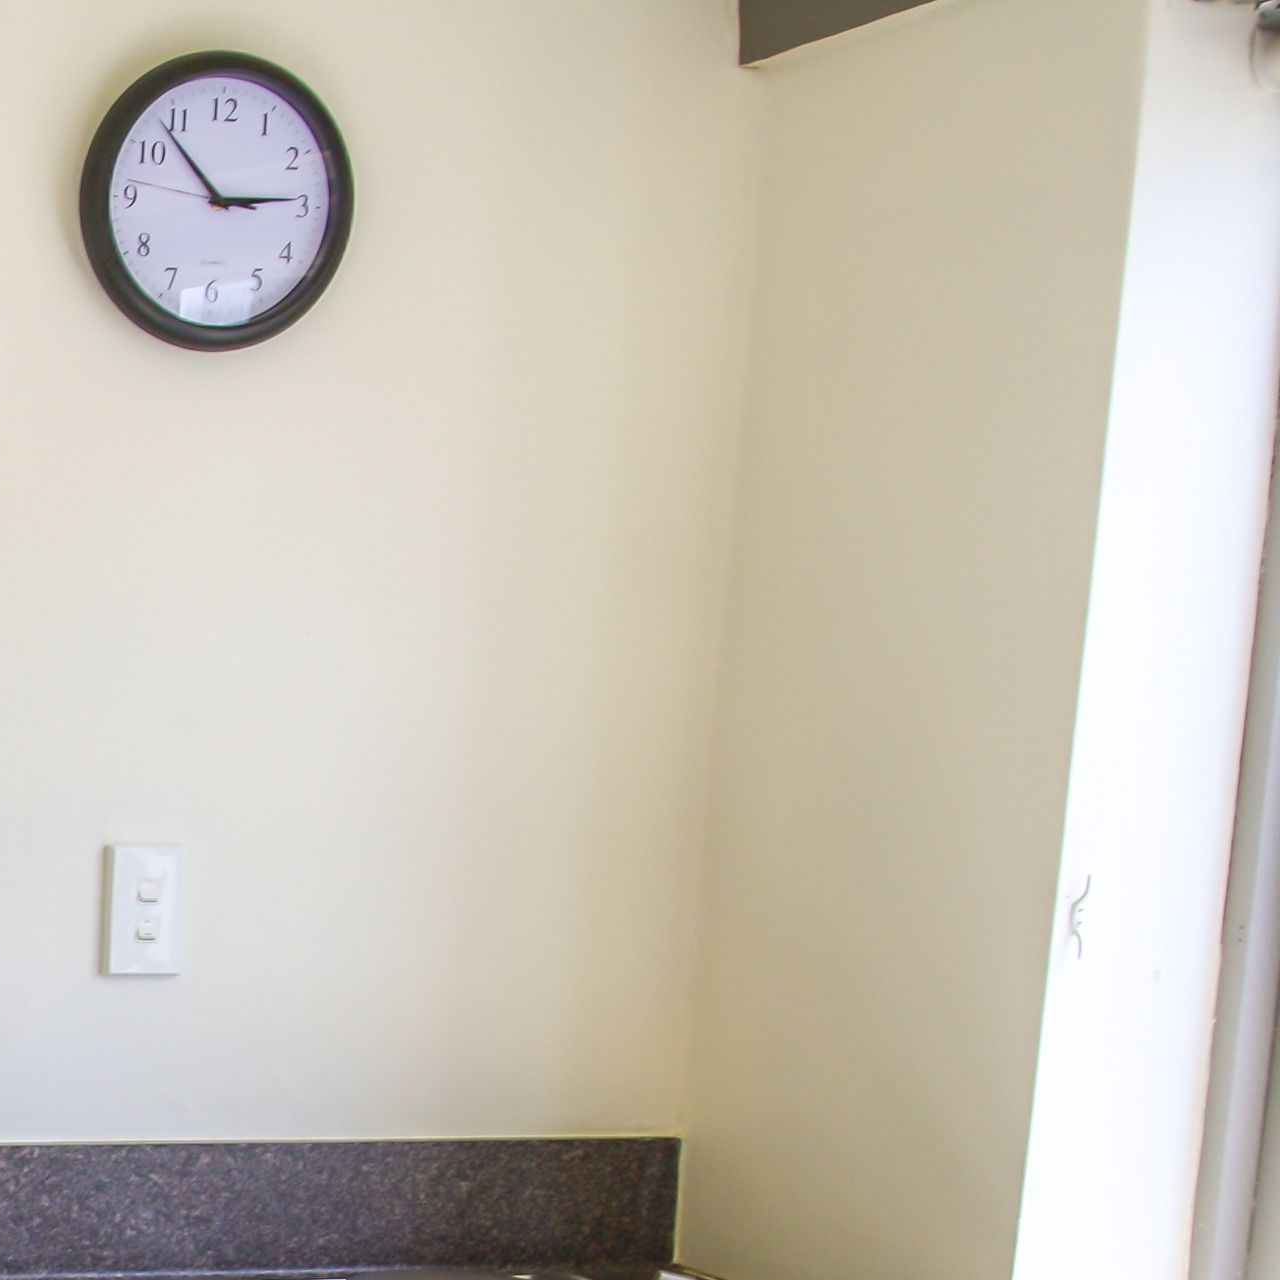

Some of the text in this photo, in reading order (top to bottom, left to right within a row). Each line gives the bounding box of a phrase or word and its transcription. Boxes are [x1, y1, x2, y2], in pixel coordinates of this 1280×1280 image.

[168, 108, 187, 132] 11
[211, 97, 238, 122] 12
[260, 112, 271, 136] 1
[138, 140, 166, 165] 10
[285, 146, 299, 170] 2
[123, 183, 138, 209] 9
[295, 194, 310, 218] 3
[137, 232, 151, 257] 8
[278, 241, 293, 264] 4
[164, 267, 178, 290] 7
[250, 268, 264, 291] 5
[204, 280, 219, 303] 6
